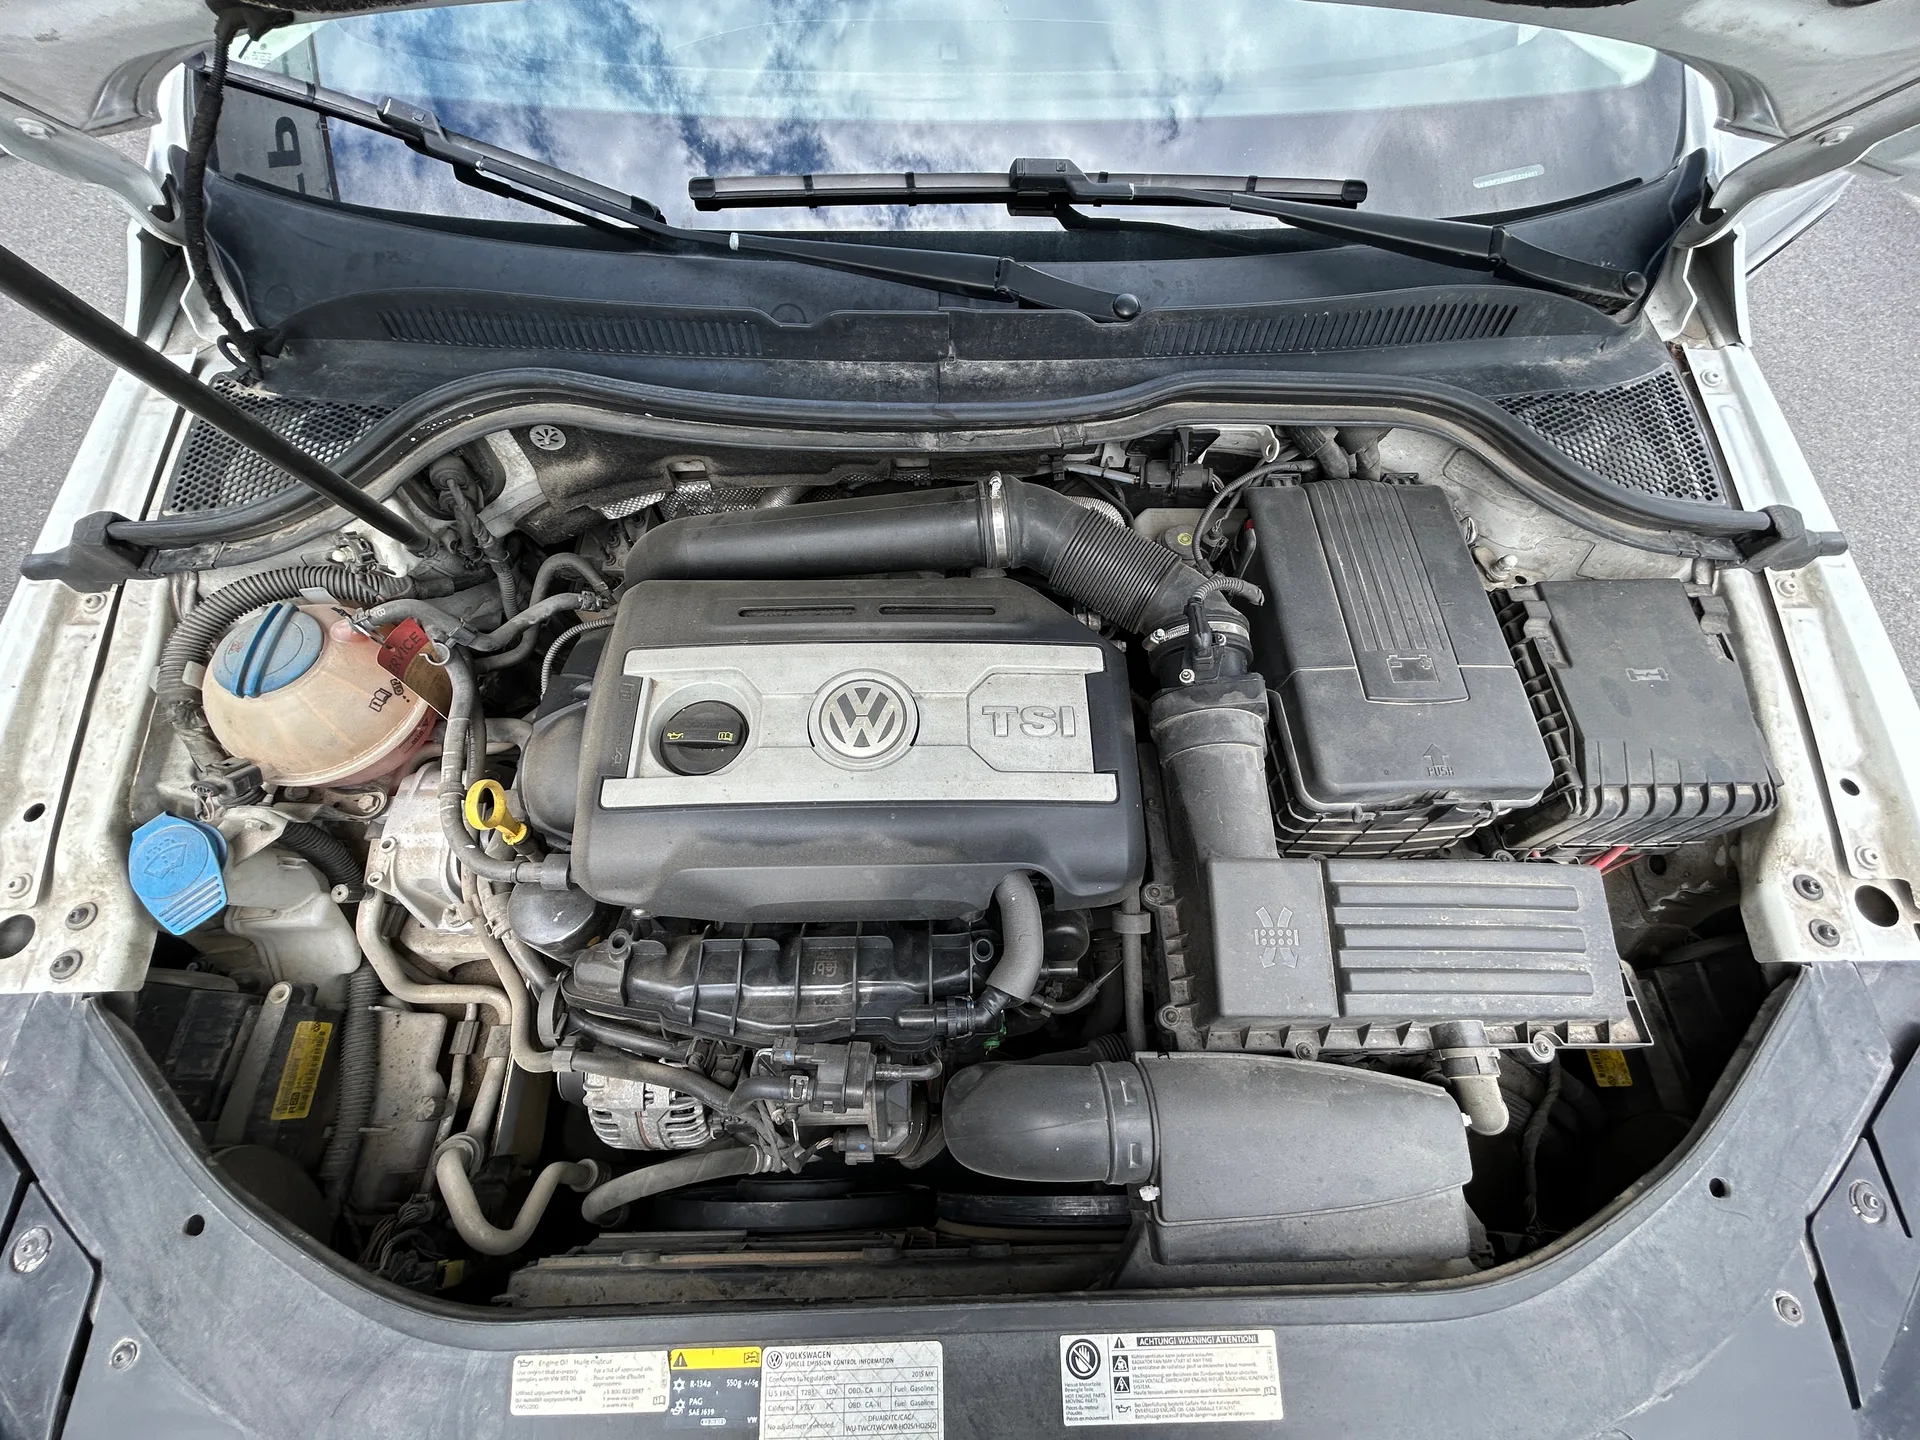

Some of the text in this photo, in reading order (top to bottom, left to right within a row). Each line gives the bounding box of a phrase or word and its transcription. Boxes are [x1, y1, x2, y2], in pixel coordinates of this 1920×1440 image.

[387, 630, 422, 676] ERVICE
[982, 705, 1076, 738] TSI
[1426, 766, 1455, 777] PUSH
[1140, 1335, 1256, 1346] ACHTUNG! WARNING! ATTENTION!
[785, 1351, 831, 1360] VOLKSWAGEN
[538, 1359, 559, 1367] Engine
[834, 1358, 857, 1366] CONTROL
[689, 1380, 712, 1388] R-134a
[688, 1398, 703, 1406] PAG
[688, 1408, 715, 1416] SAE J639
[747, 1416, 758, 1424] VW
